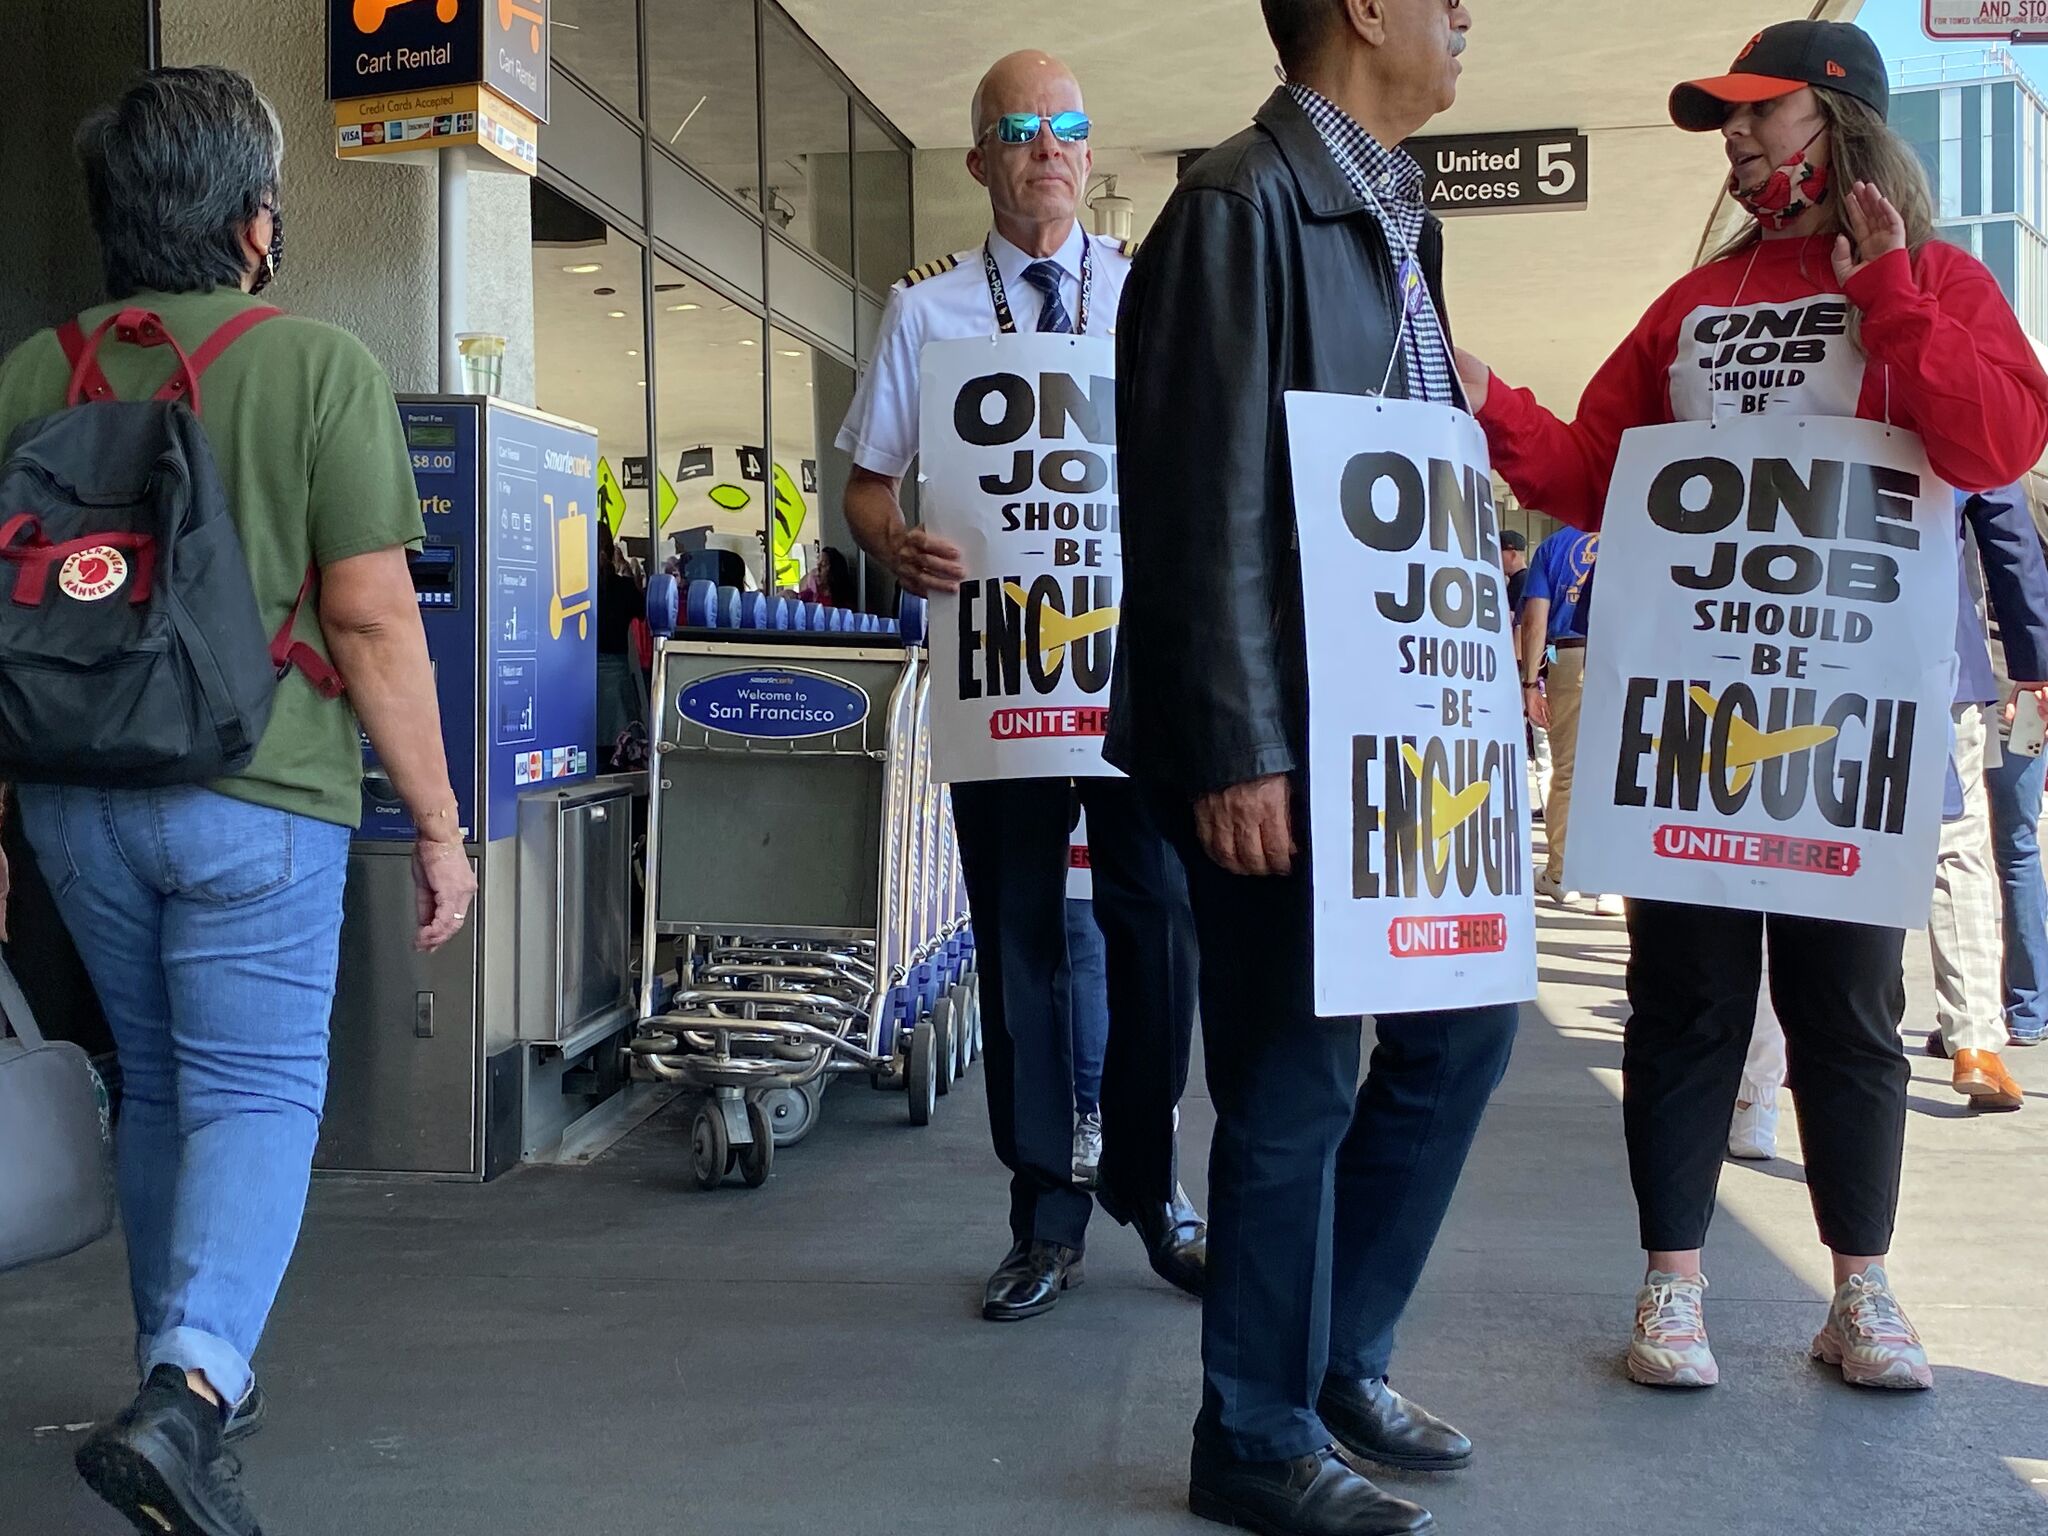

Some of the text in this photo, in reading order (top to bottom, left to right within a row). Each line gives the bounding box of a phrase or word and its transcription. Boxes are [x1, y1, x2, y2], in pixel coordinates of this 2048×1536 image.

[1980, 1, 2011, 17] AND
[356, 42, 450, 75] Cart Rental
[499, 48, 537, 92] Cart Rental
[359, 91, 454, 115] Credit Cards Accepted
[342, 131, 360, 141] VISA
[1437, 148, 1520, 174] United
[1537, 142, 1577, 196] 5
[1430, 180, 1520, 202] Access
[1694, 302, 1848, 344] ONE
[1699, 339, 1826, 369] JOB
[1708, 369, 1805, 391] SHOULD
[413, 455, 452, 469] $8.00
[979, 449, 1118, 496] JO
[1340, 451, 1500, 570] ONE
[1646, 456, 1921, 551] ONE
[1670, 541, 1901, 604] JOB
[1375, 562, 1501, 634] JOB
[1693, 600, 1873, 644] SHOULD
[1399, 634, 1497, 682] SHOULD
[709, 702, 835, 722] San Francisco
[737, 689, 808, 702] Welcome to
[1613, 677, 1917, 835] ENOUGH
[375, 806, 401, 815] Change
[1352, 734, 1522, 899] ENOUGH
